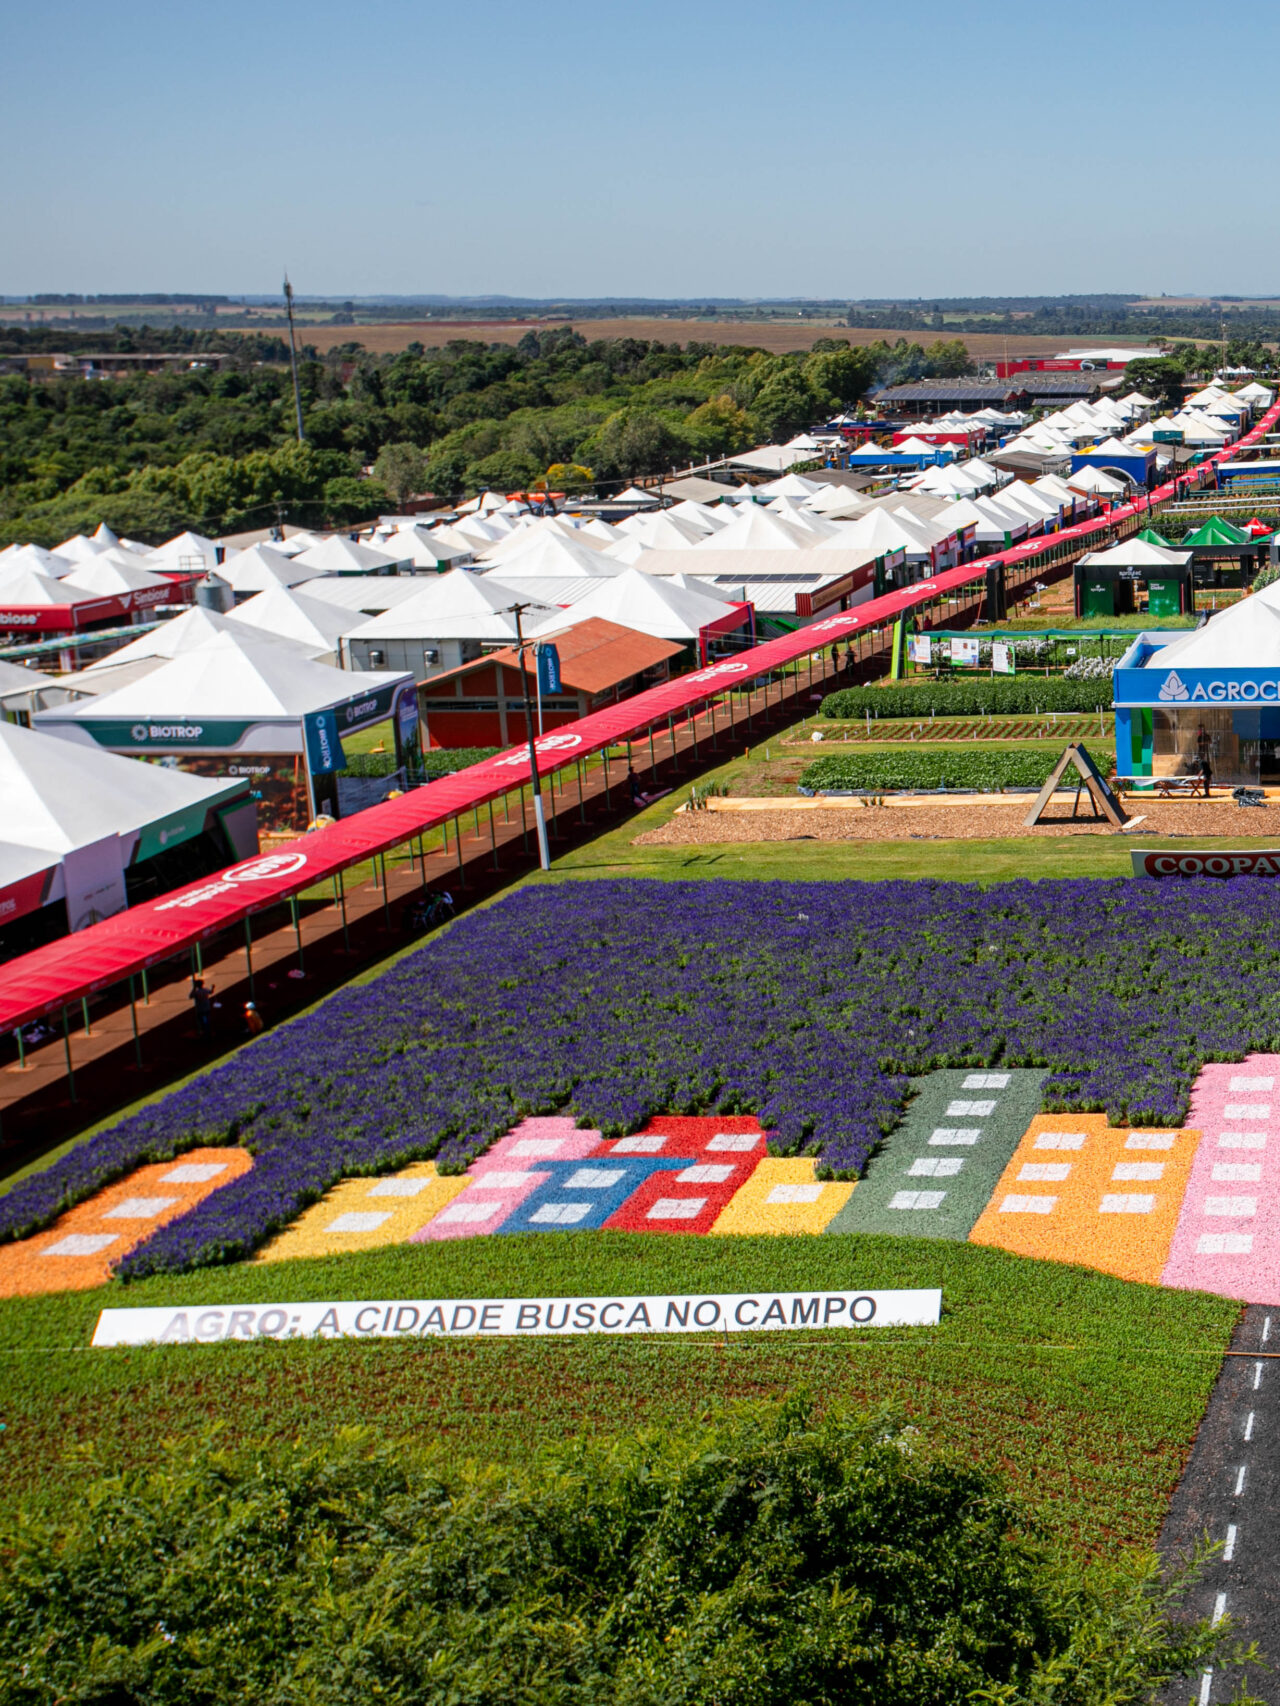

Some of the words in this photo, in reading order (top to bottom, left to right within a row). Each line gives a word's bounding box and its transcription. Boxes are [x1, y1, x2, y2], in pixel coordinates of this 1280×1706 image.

[0, 612, 37, 624] biose
[150, 726, 203, 738] BIOTROP
[239, 766, 270, 774] BIOTROP
[160, 1308, 302, 1339] AGRO:
[314, 1307, 341, 1333] A
[354, 1305, 504, 1332] CIDADE
[515, 1302, 652, 1329] BUSCA
[664, 1300, 722, 1327] NO
[734, 1296, 878, 1325] CAMPO
